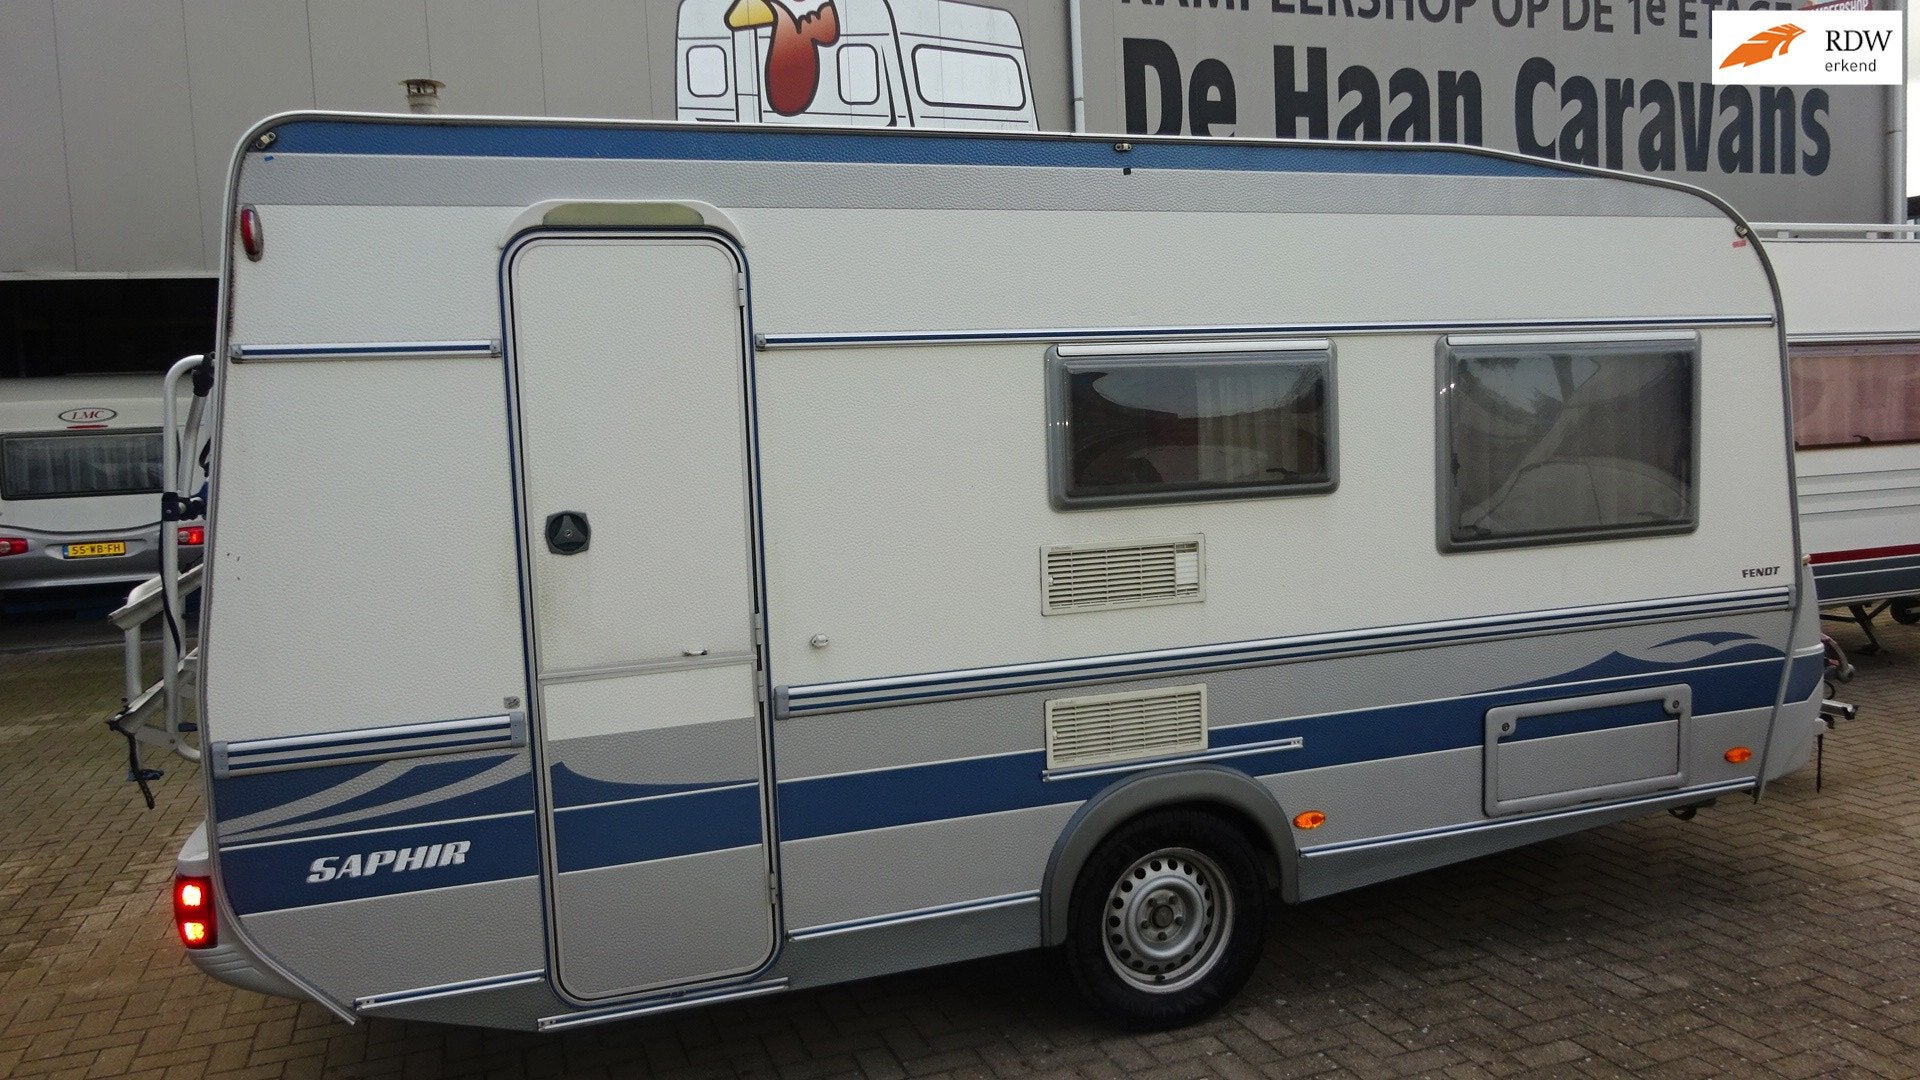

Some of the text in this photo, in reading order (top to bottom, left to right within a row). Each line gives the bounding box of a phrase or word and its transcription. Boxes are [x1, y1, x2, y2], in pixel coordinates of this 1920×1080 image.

[1492, 0, 1550, 28] OP
[1562, 0, 1614, 33] DE
[1122, 37, 1831, 176] De Haan Caravans
[72, 411, 104, 419] LMC
[1742, 566, 1780, 578] FENDT
[306, 840, 471, 883] SAPHIR
